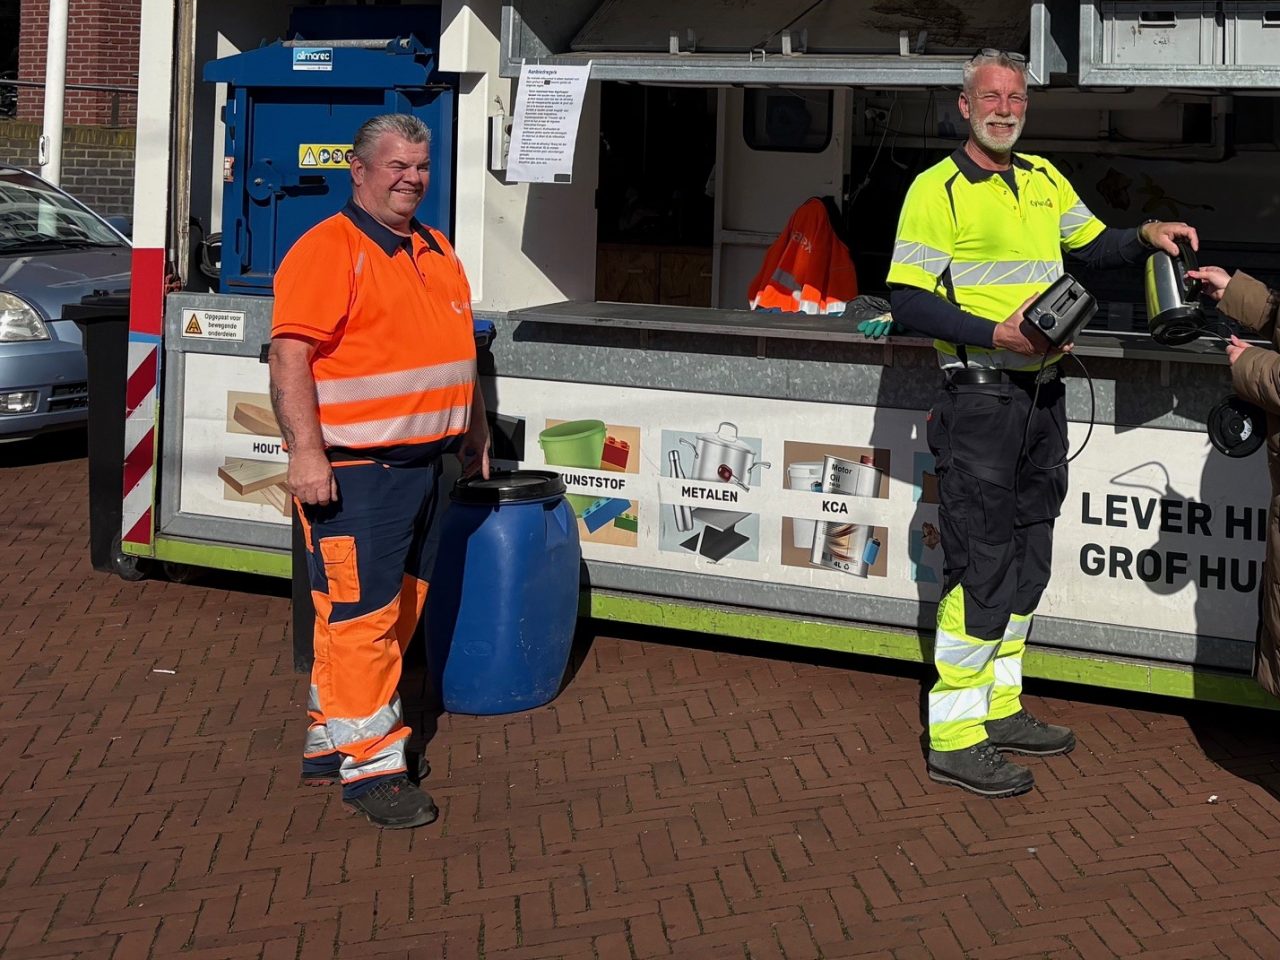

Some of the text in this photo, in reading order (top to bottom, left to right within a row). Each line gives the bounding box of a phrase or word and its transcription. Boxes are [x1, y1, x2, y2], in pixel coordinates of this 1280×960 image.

[253, 442, 281, 455] HOUT
[832, 464, 853, 475] Motor
[830, 473, 840, 483] Oil
[681, 486, 738, 503] METALEN
[821, 500, 849, 515] KCA
[1081, 491, 1213, 537] LEVER
[1226, 505, 1267, 542] HI
[1079, 542, 1189, 586] GROF
[1199, 555, 1266, 593] HU
